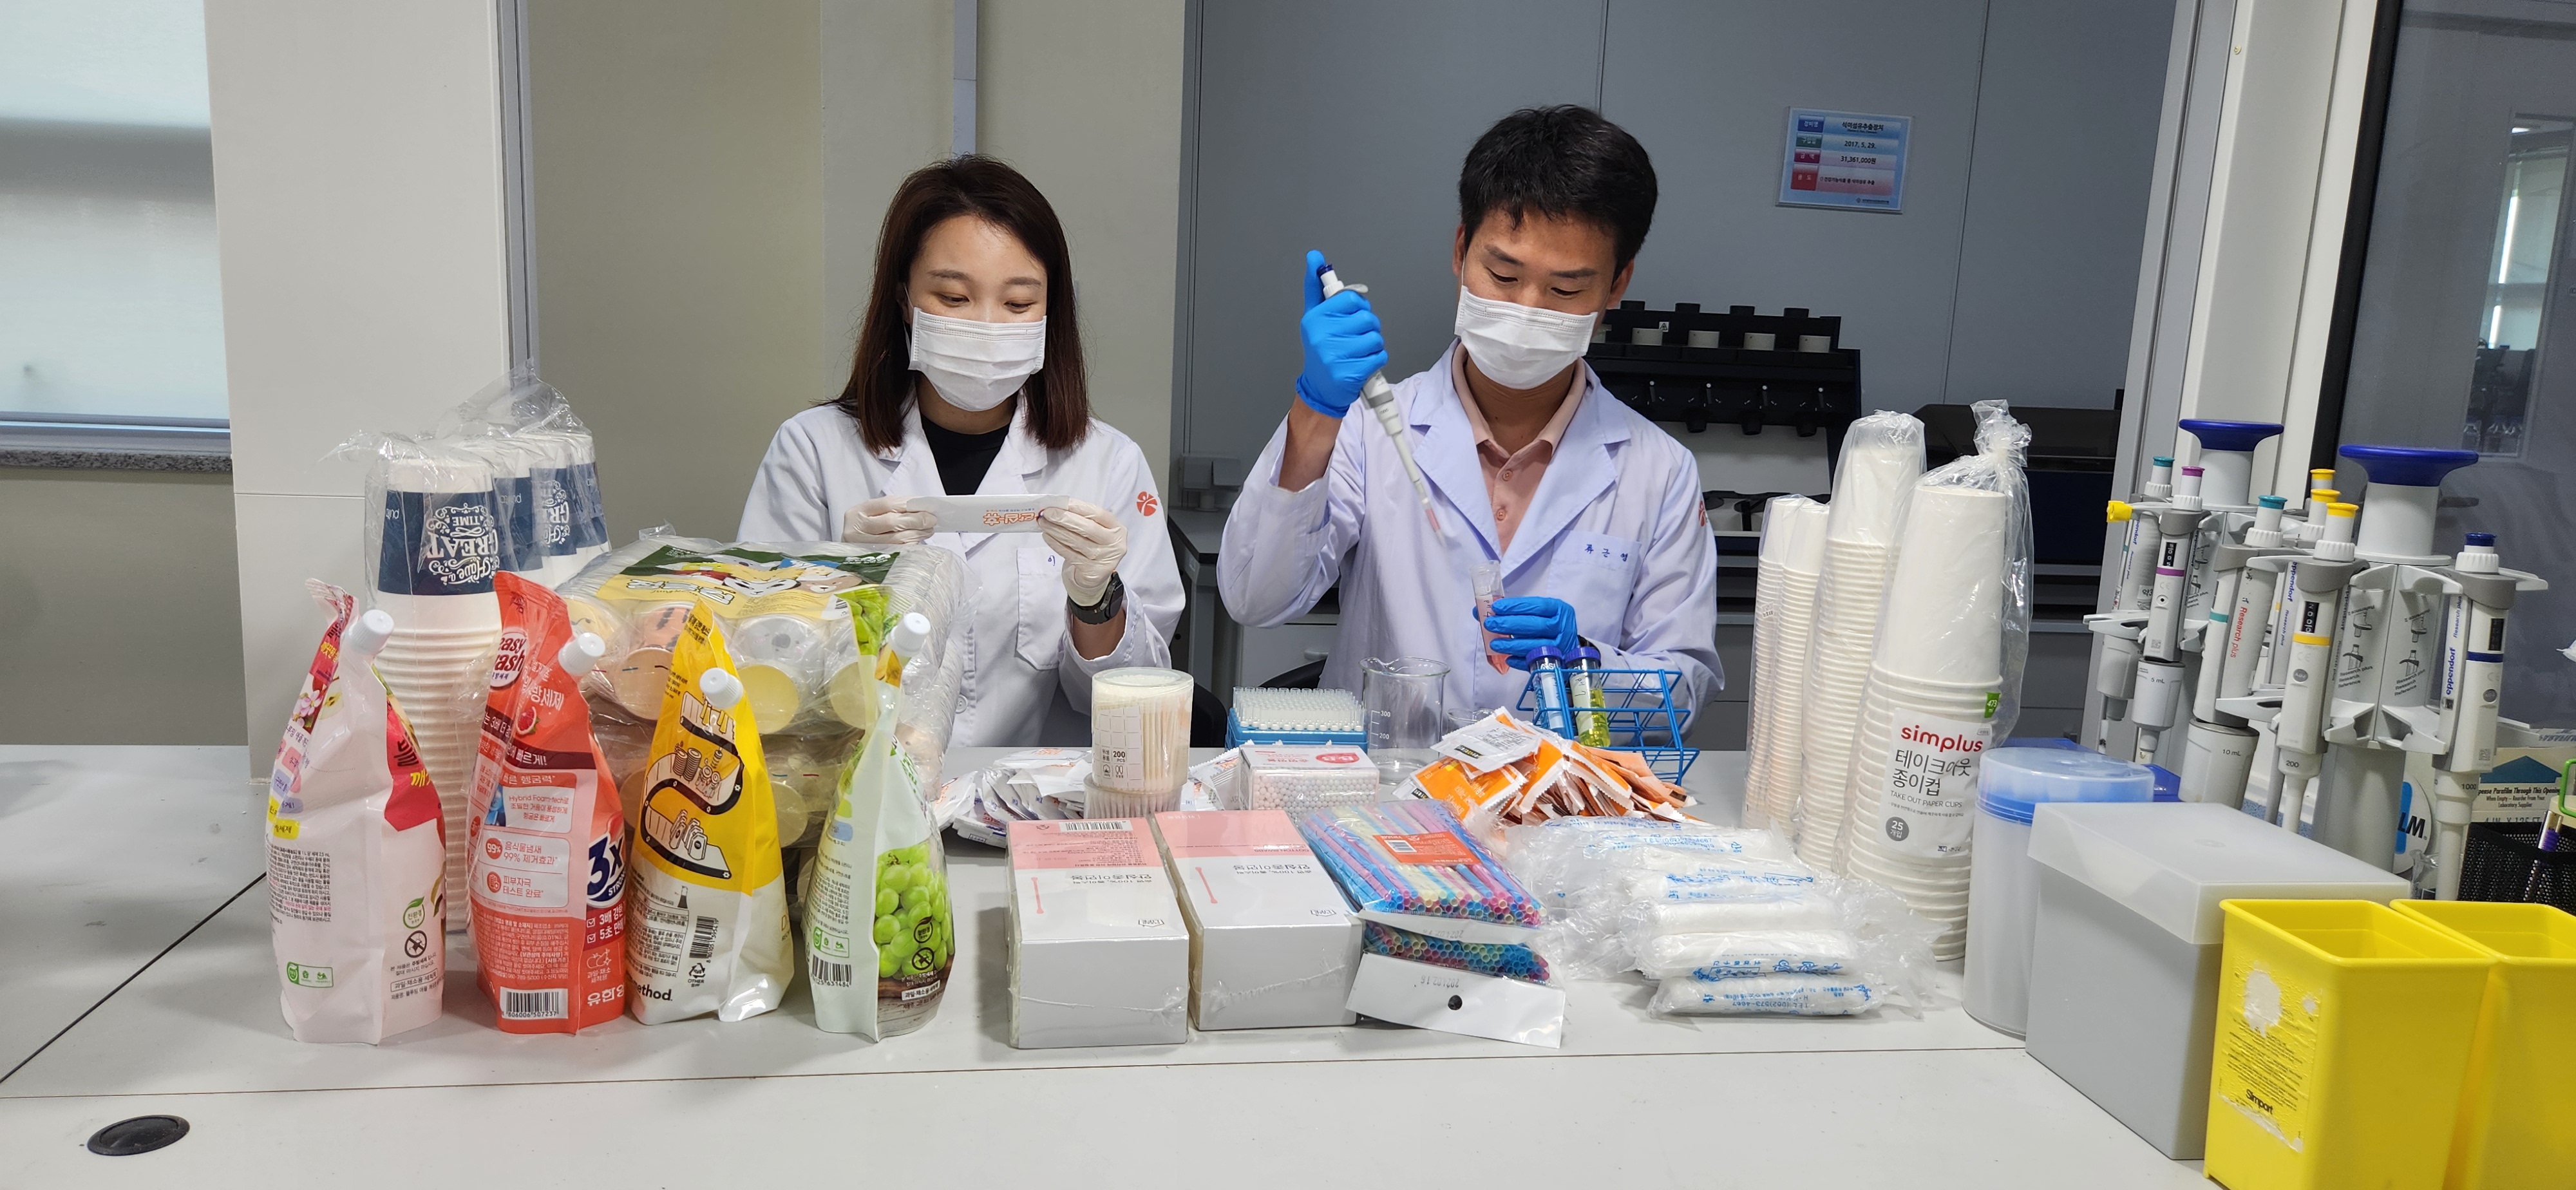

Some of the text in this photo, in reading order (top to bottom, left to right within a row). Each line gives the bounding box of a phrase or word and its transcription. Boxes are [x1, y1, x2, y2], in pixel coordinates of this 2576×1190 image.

[1842, 120, 1884, 131] 식이섬유추출장치
[1841, 155, 1876, 164] 31,361,000원
[452, 516, 480, 527] TIME
[426, 528, 498, 559] GREAT
[457, 556, 493, 581] Have
[2288, 562, 2297, 602] ppendorf
[2230, 607, 2248, 658] Research plus
[495, 649, 525, 672] ash
[2340, 666, 2361, 677] Research
[2446, 646, 2456, 695] eppendorf
[1987, 699, 1998, 708] 473
[1900, 724, 1984, 753] simplus
[515, 748, 547, 766] 빠르게!
[1113, 750, 1126, 759] 200
[1895, 749, 1972, 777] 테이크아웃
[1892, 768, 1941, 797] 종이컵
[1890, 790, 1906, 801] TAKE
[1907, 793, 1922, 804] OUT
[2514, 787, 2532, 795] Through
[509, 795, 532, 803] Hybrid
[1891, 820, 1904, 831] 25
[1889, 828, 1903, 838] 개입
[486, 842, 502, 853] 99%
[504, 841, 542, 854] 음식물냄새
[503, 852, 554, 865] 99% 제거효과
[503, 875, 531, 887] 피부자극
[503, 885, 541, 898] 테스트 완료
[407, 909, 422, 921] 친환경
[599, 909, 612, 925] 3배
[600, 925, 613, 940] 5초
[2246, 1089, 2274, 1115] Simport
